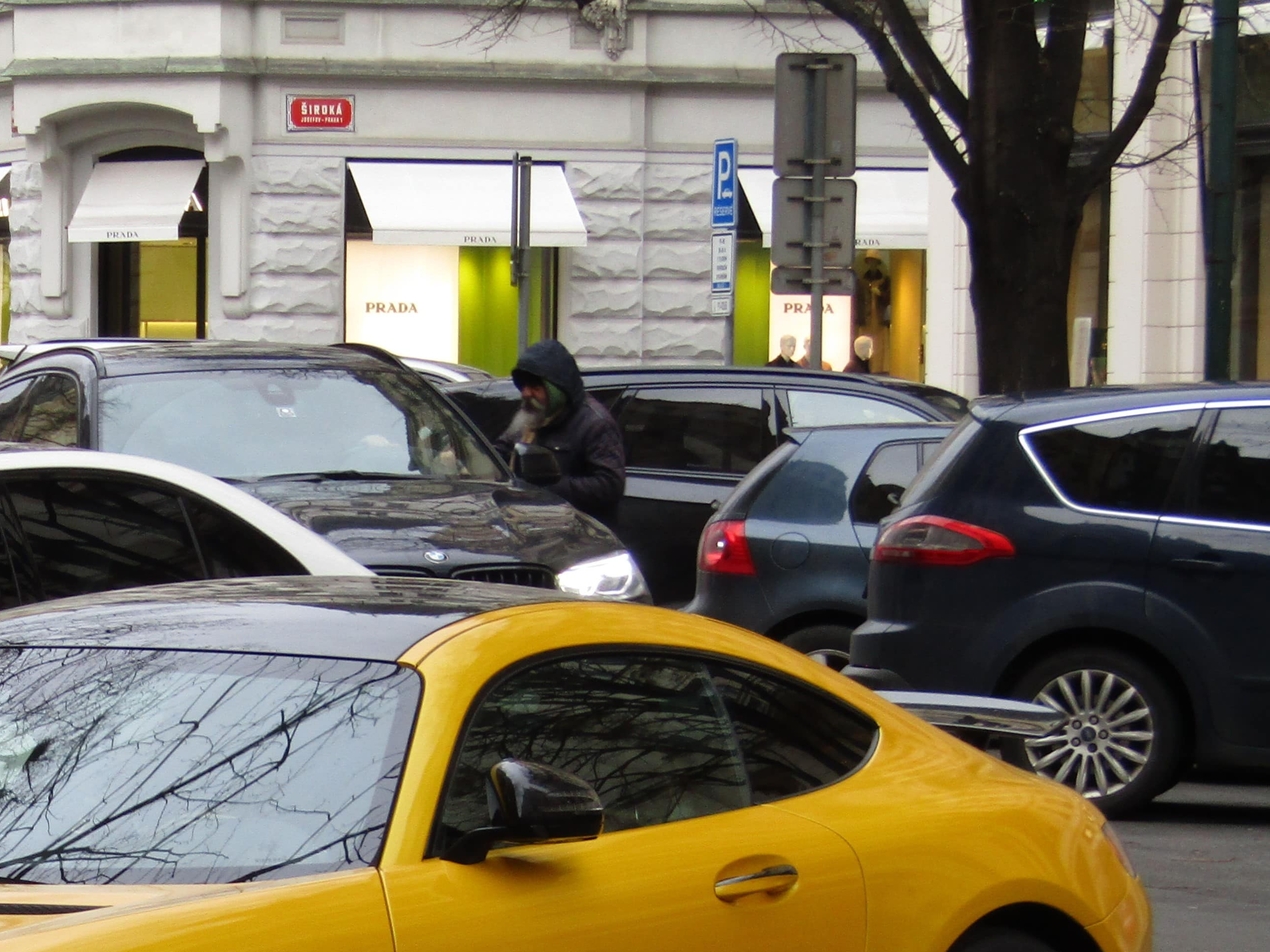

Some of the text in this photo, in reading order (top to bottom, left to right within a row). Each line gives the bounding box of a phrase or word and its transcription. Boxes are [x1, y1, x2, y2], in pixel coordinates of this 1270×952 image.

[301, 101, 343, 116] ŠIROKÁ
[716, 150, 731, 200] P
[106, 231, 139, 239] PRADA
[463, 236, 498, 244] PRADA
[365, 302, 419, 314] PRADA
[783, 302, 835, 314] PRAA
